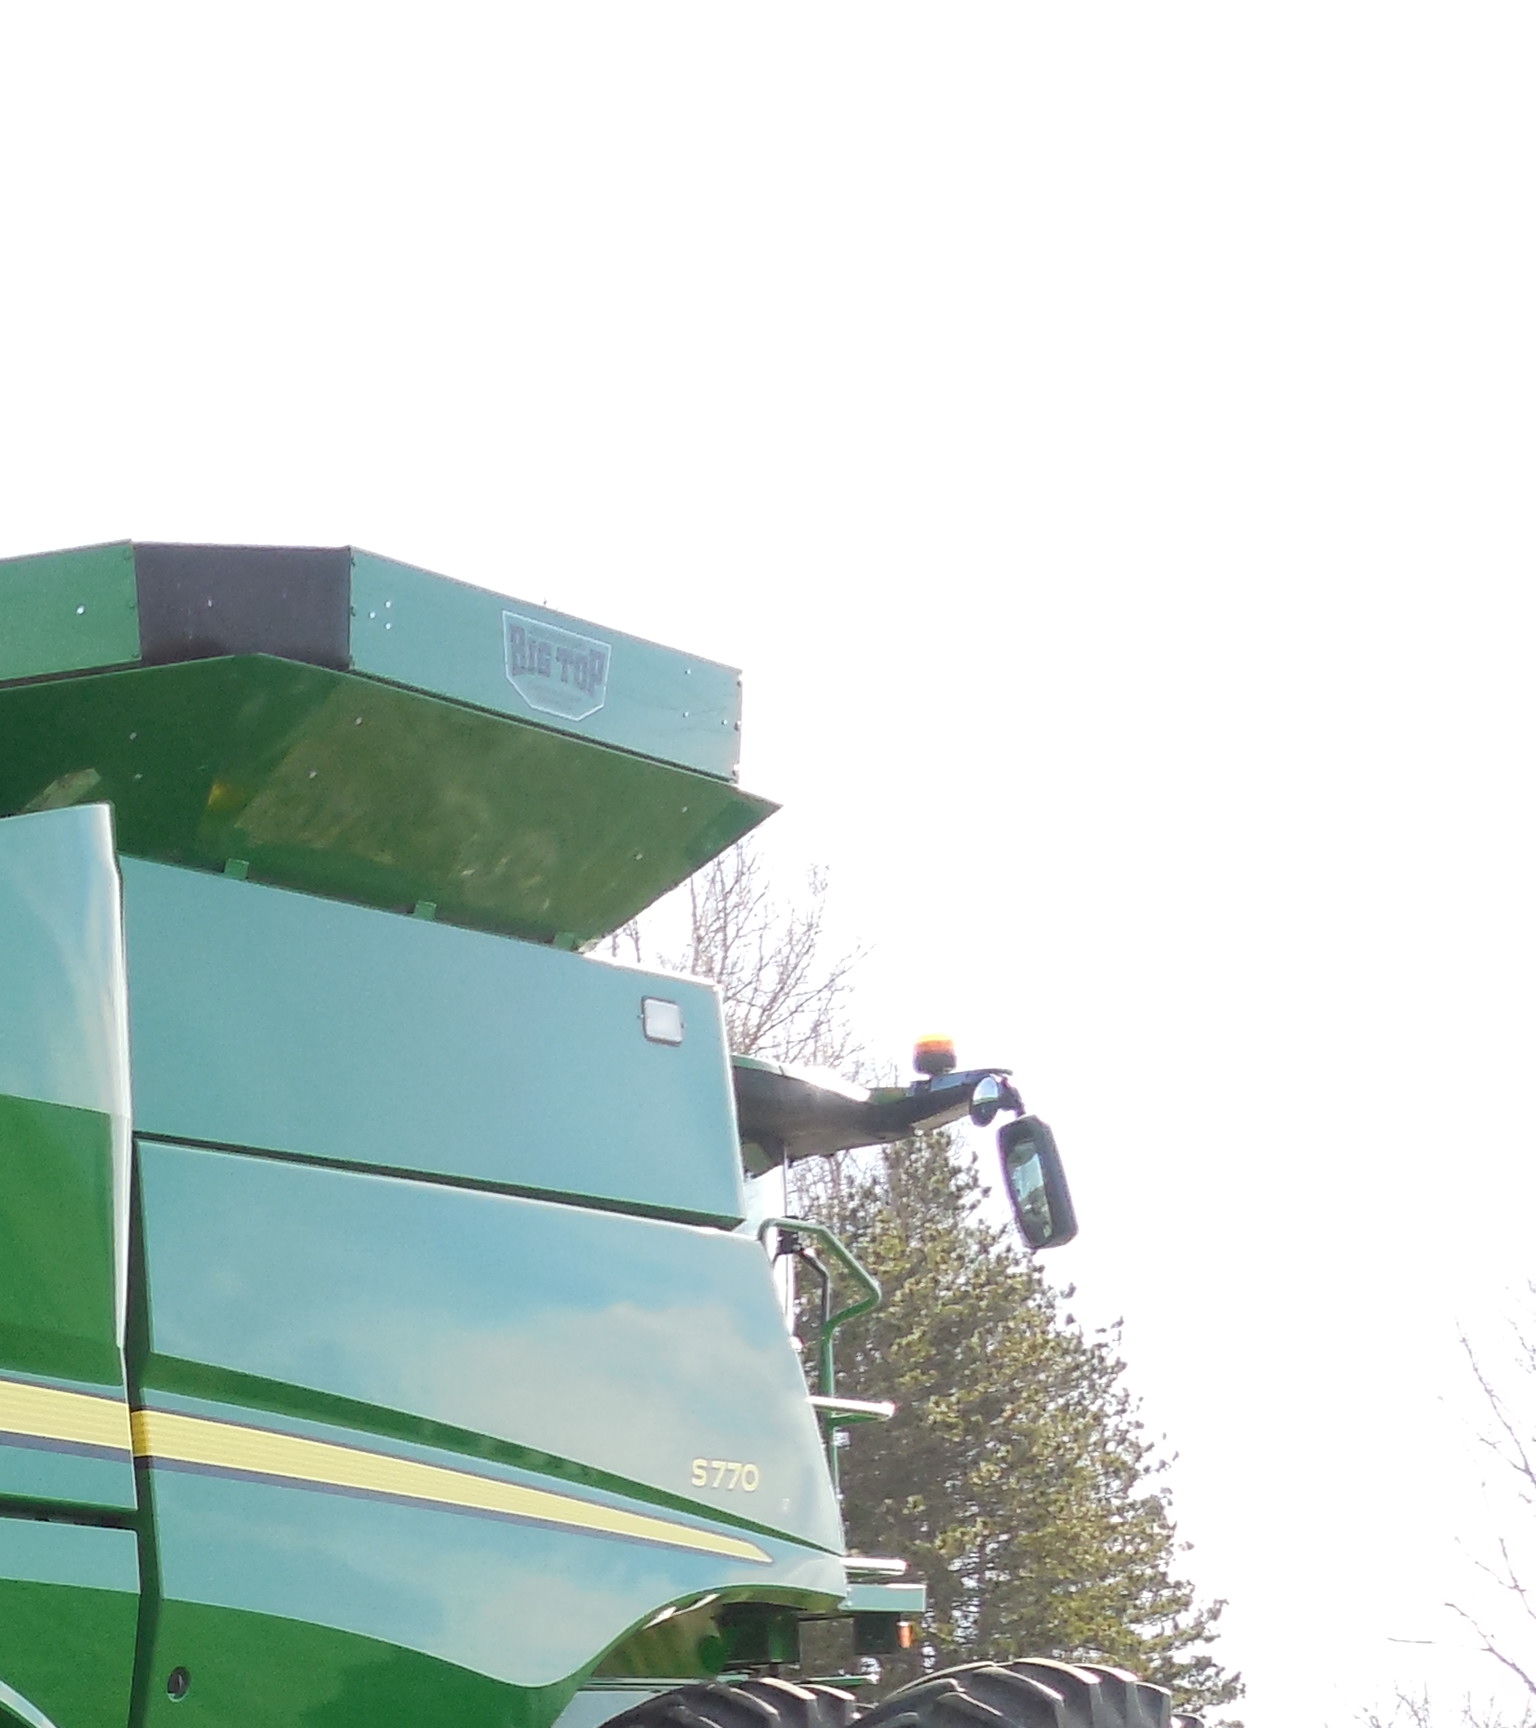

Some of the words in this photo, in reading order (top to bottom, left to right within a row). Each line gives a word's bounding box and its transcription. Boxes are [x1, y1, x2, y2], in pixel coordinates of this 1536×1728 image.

[509, 623, 551, 678] BIG
[555, 646, 607, 697] TOP
[691, 1458, 760, 1492] S770
